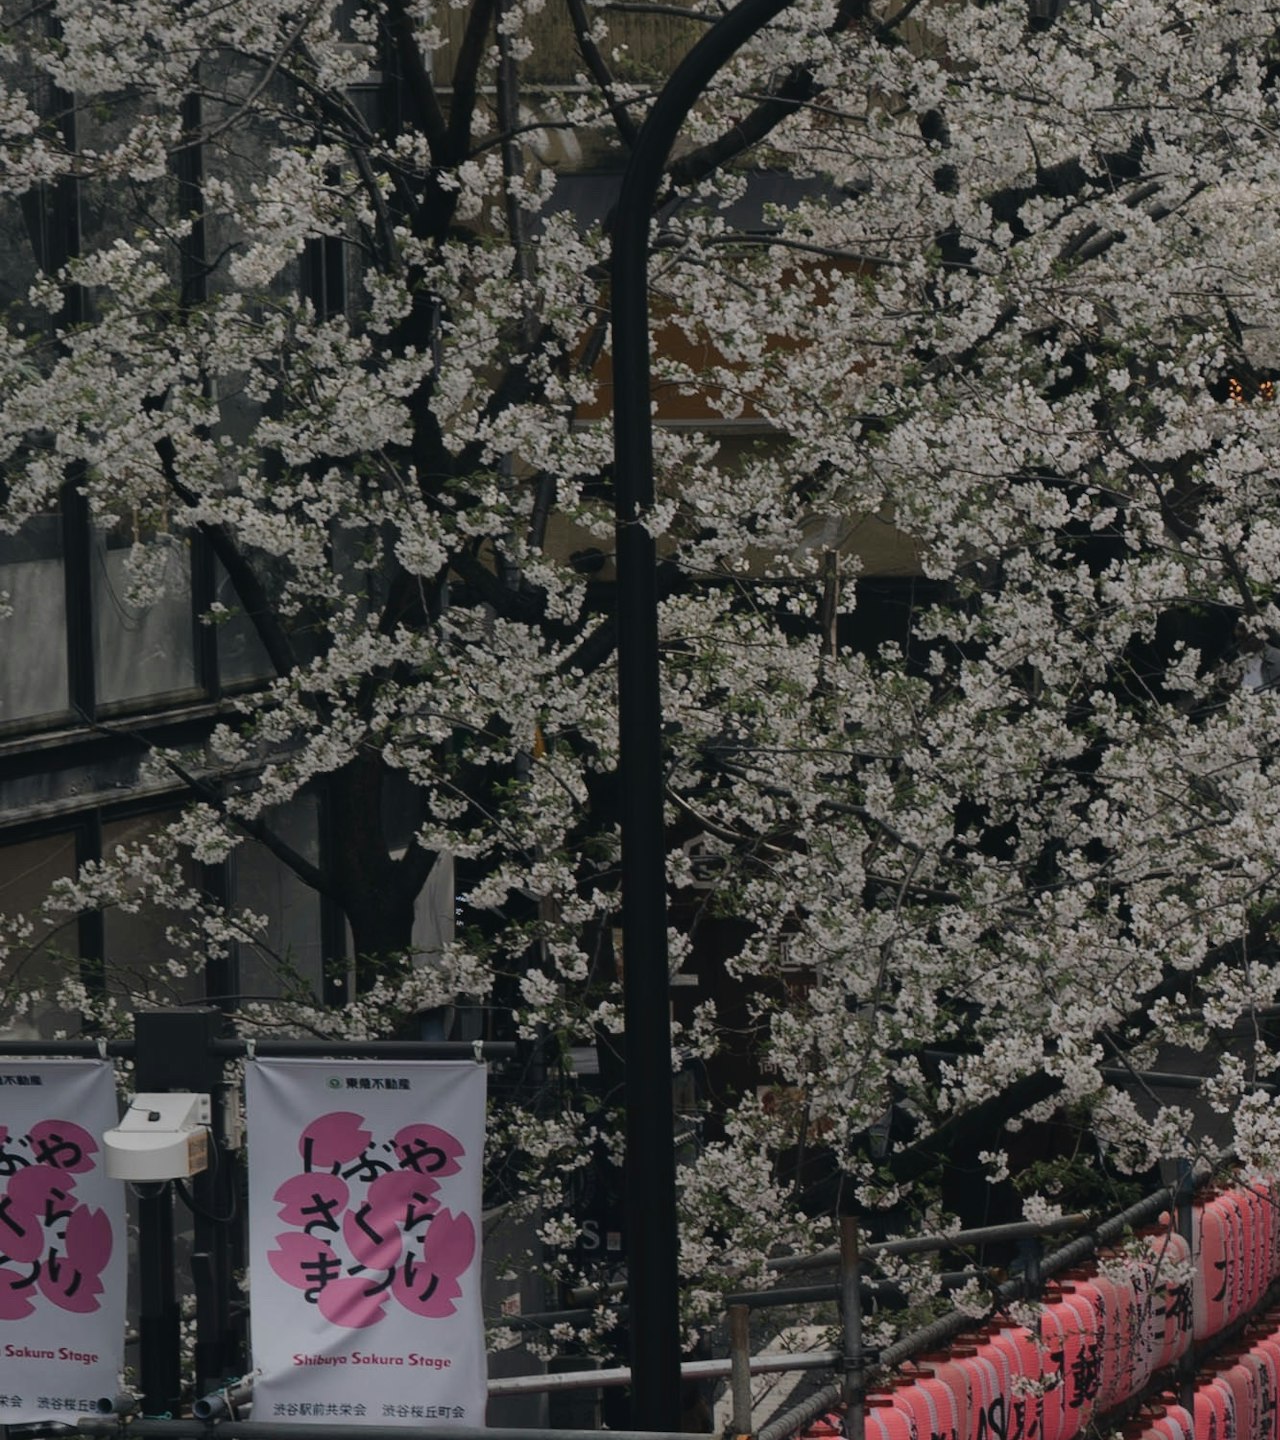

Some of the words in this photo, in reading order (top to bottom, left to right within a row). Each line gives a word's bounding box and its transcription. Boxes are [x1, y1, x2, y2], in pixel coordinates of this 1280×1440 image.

[304, 1137, 447, 1182] しぶや
[301, 1192, 435, 1246] さくら
[300, 1251, 439, 1304] まつり
[5, 1344, 55, 1360] Sakura
[58, 1347, 99, 1364] Stage
[292, 1353, 348, 1368] Shibuya
[351, 1351, 404, 1366] Sakura
[408, 1353, 452, 1370] Stage
[272, 1403, 367, 1417] 渋谷駅前共栄会
[382, 1404, 466, 1419] 渋谷桜丘町会
